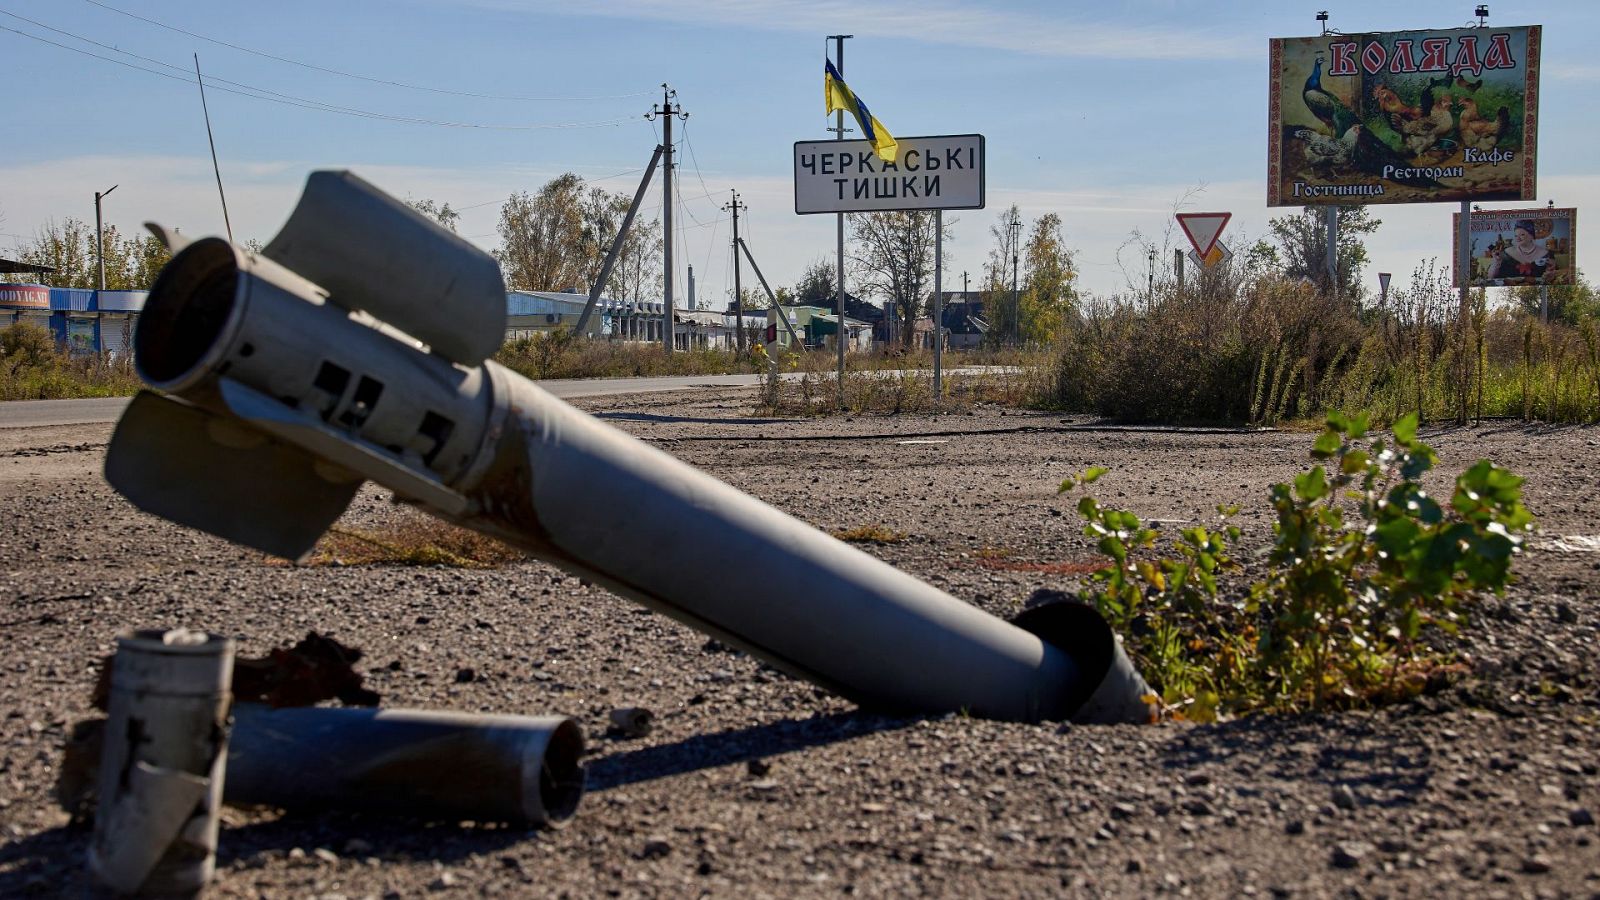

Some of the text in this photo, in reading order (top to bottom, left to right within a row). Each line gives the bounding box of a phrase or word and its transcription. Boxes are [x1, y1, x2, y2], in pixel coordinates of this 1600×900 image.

[1329, 33, 1515, 76] КОЛЯДА
[1464, 147, 1514, 165] Кафе
[1383, 164, 1464, 180] Ресторан
[833, 175, 940, 200] ТИШКИ
[1293, 182, 1384, 198] Гостиница
